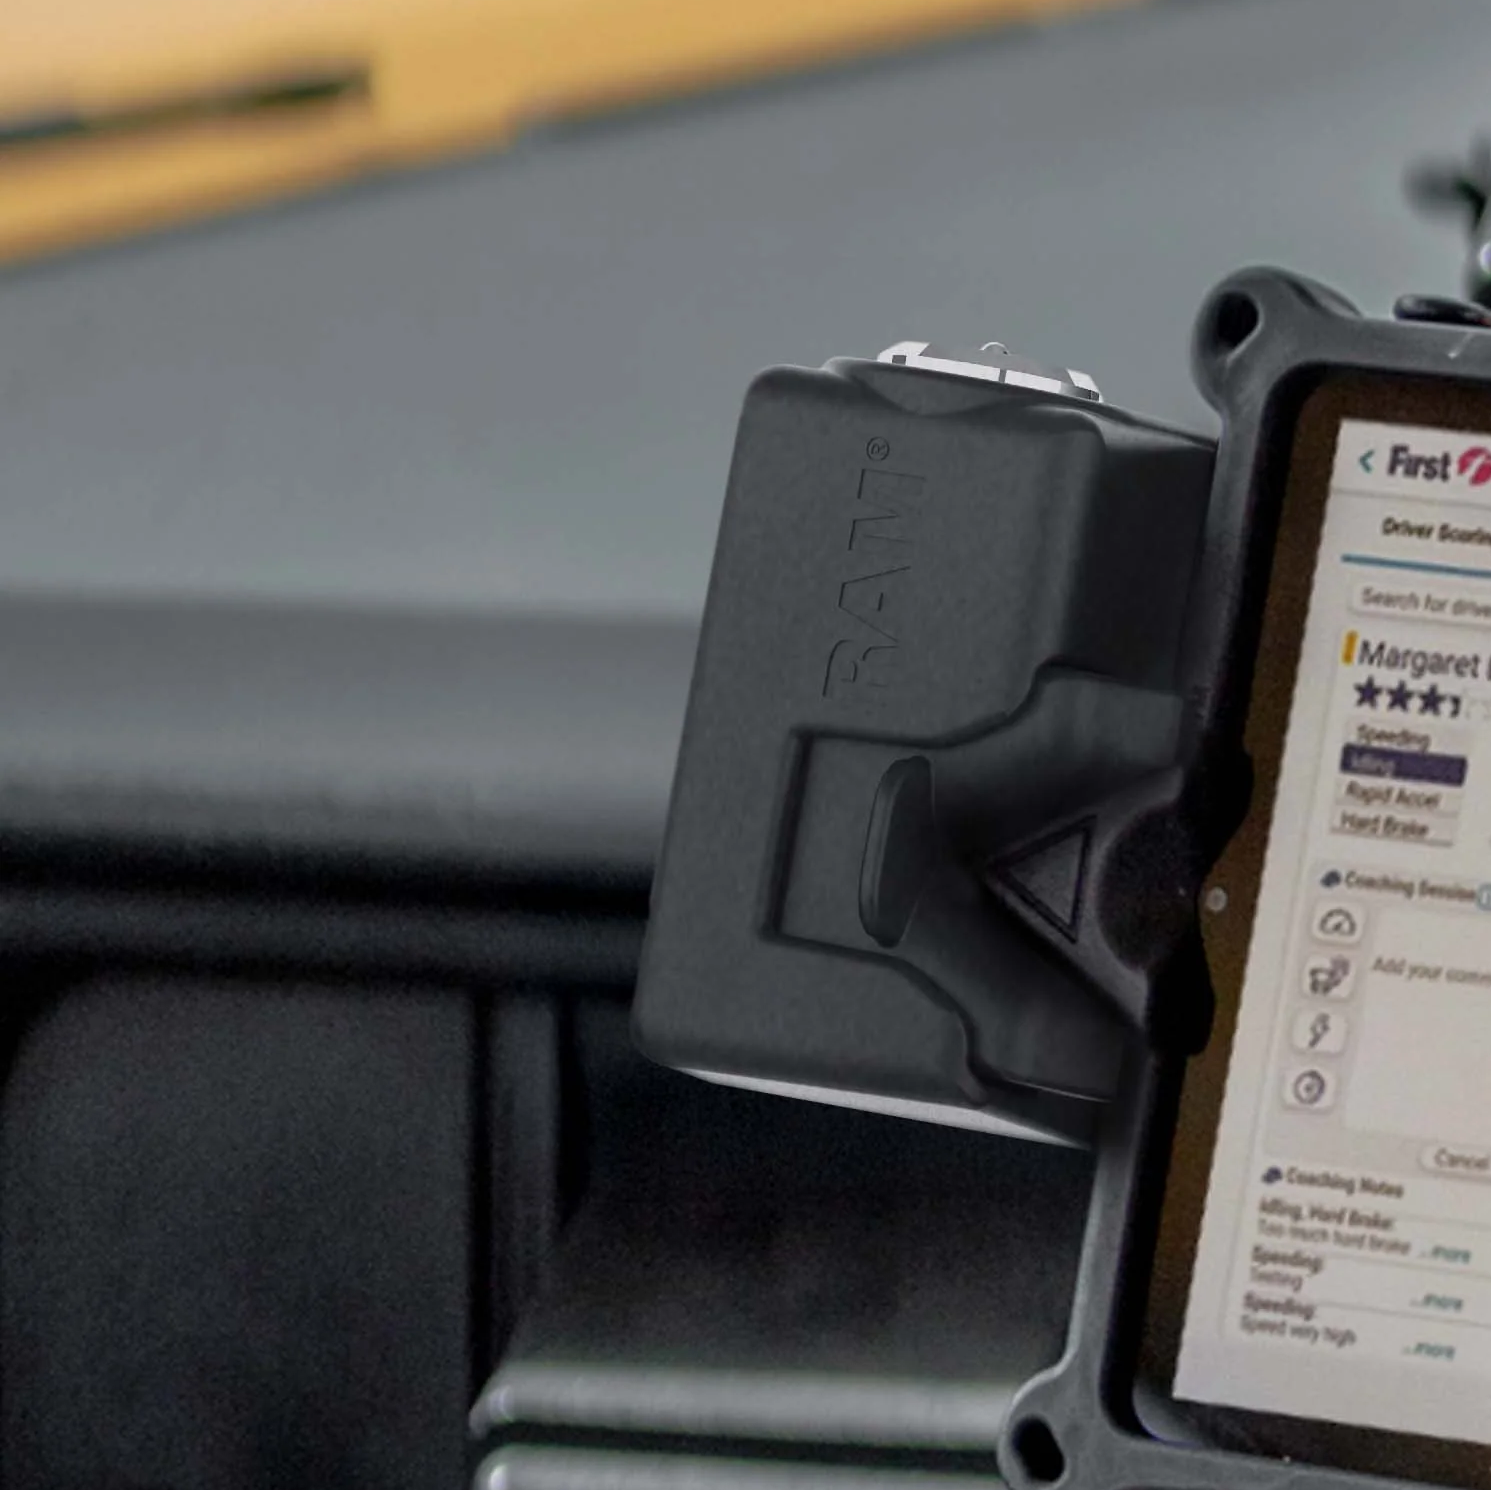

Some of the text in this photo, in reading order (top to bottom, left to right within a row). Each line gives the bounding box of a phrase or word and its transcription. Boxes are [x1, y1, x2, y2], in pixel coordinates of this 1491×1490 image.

[1387, 444, 1451, 482] First
[1381, 516, 1434, 540] Driver
[1361, 586, 1420, 611] Search
[1423, 594, 1450, 612] for
[1358, 639, 1483, 679] Margaret
[1356, 723, 1431, 752] Speeding
[1345, 870, 1415, 900] Coaching
[1372, 956, 1406, 976] Add
[1407, 961, 1444, 981] your
[1433, 1146, 1491, 1172] Cancel
[1286, 1165, 1406, 1200] Coaching Notes
